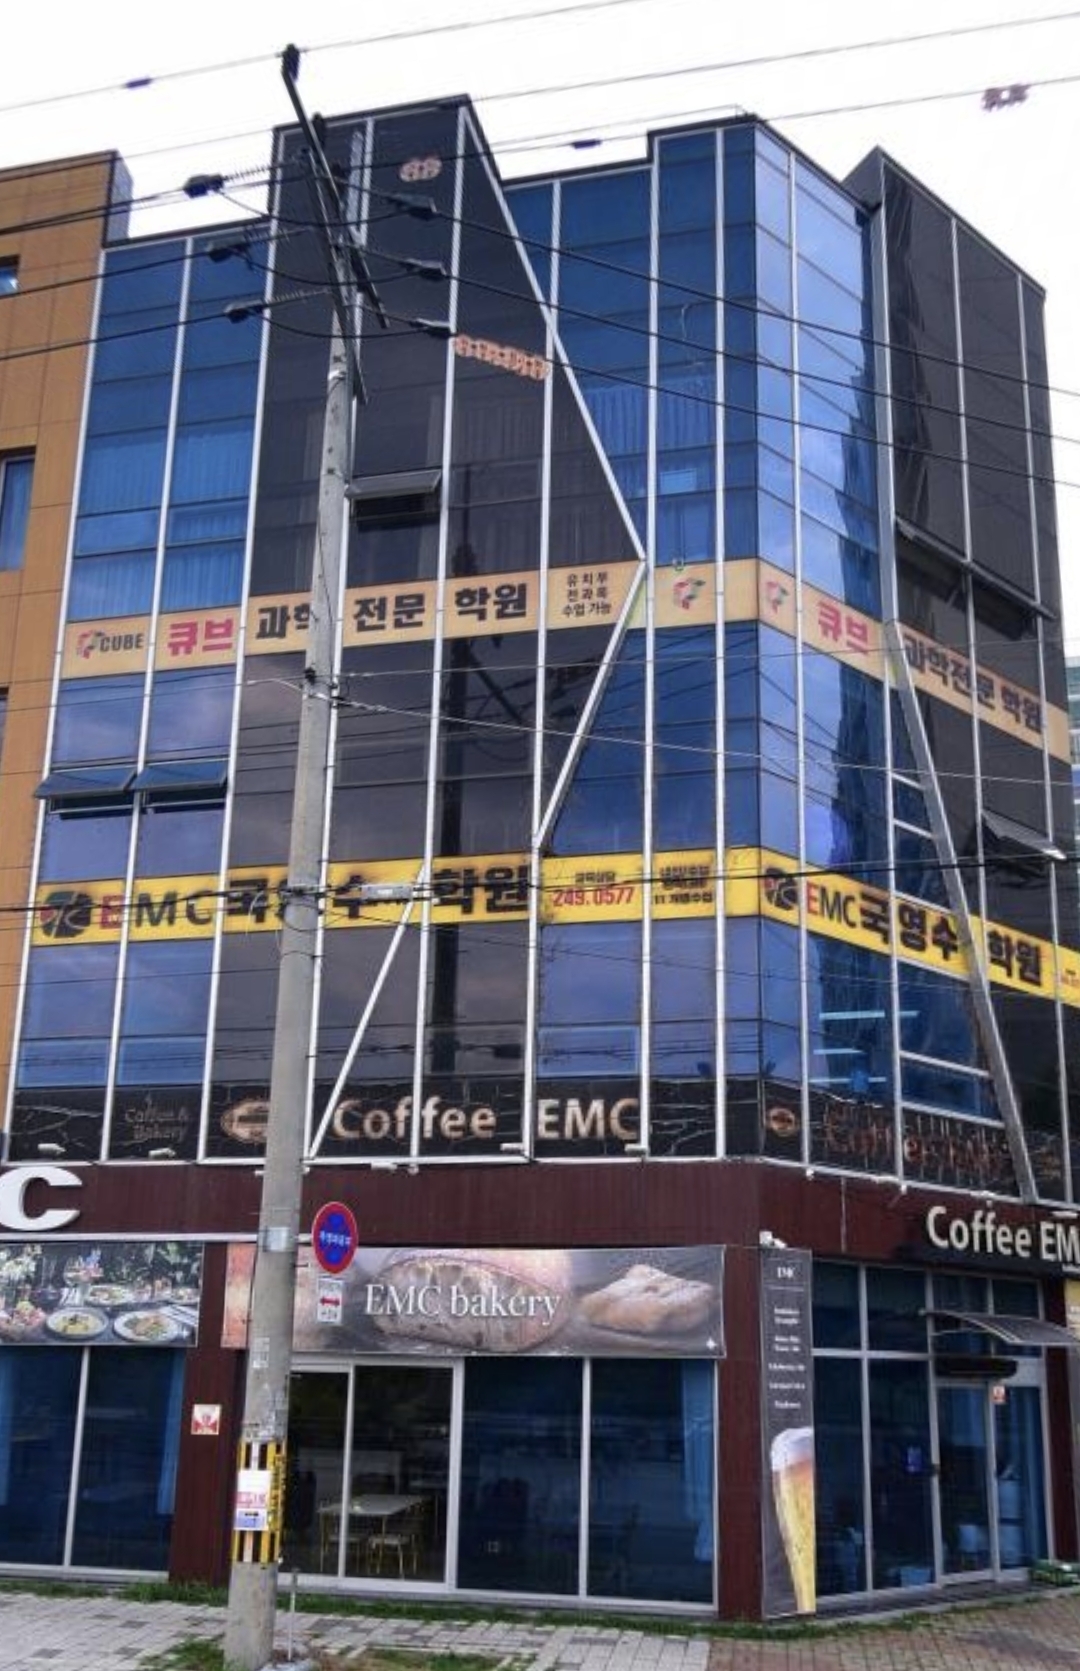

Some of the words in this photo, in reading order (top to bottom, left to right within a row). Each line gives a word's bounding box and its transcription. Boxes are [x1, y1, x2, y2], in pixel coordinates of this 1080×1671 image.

[100, 632, 144, 651] CUBE
[167, 617, 234, 656] 큐브
[352, 592, 426, 632] 전문
[453, 582, 528, 622] 학원
[818, 601, 869, 655] 큐브
[432, 865, 531, 915] 학원
[806, 881, 858, 930] EMC
[988, 929, 1043, 986] 학원
[333, 1095, 497, 1141] Coffee
[536, 1098, 641, 1140] EMC
[926, 1205, 1032, 1256] Coffee
[364, 1284, 442, 1316] EMC
[450, 1284, 562, 1327] bakery
